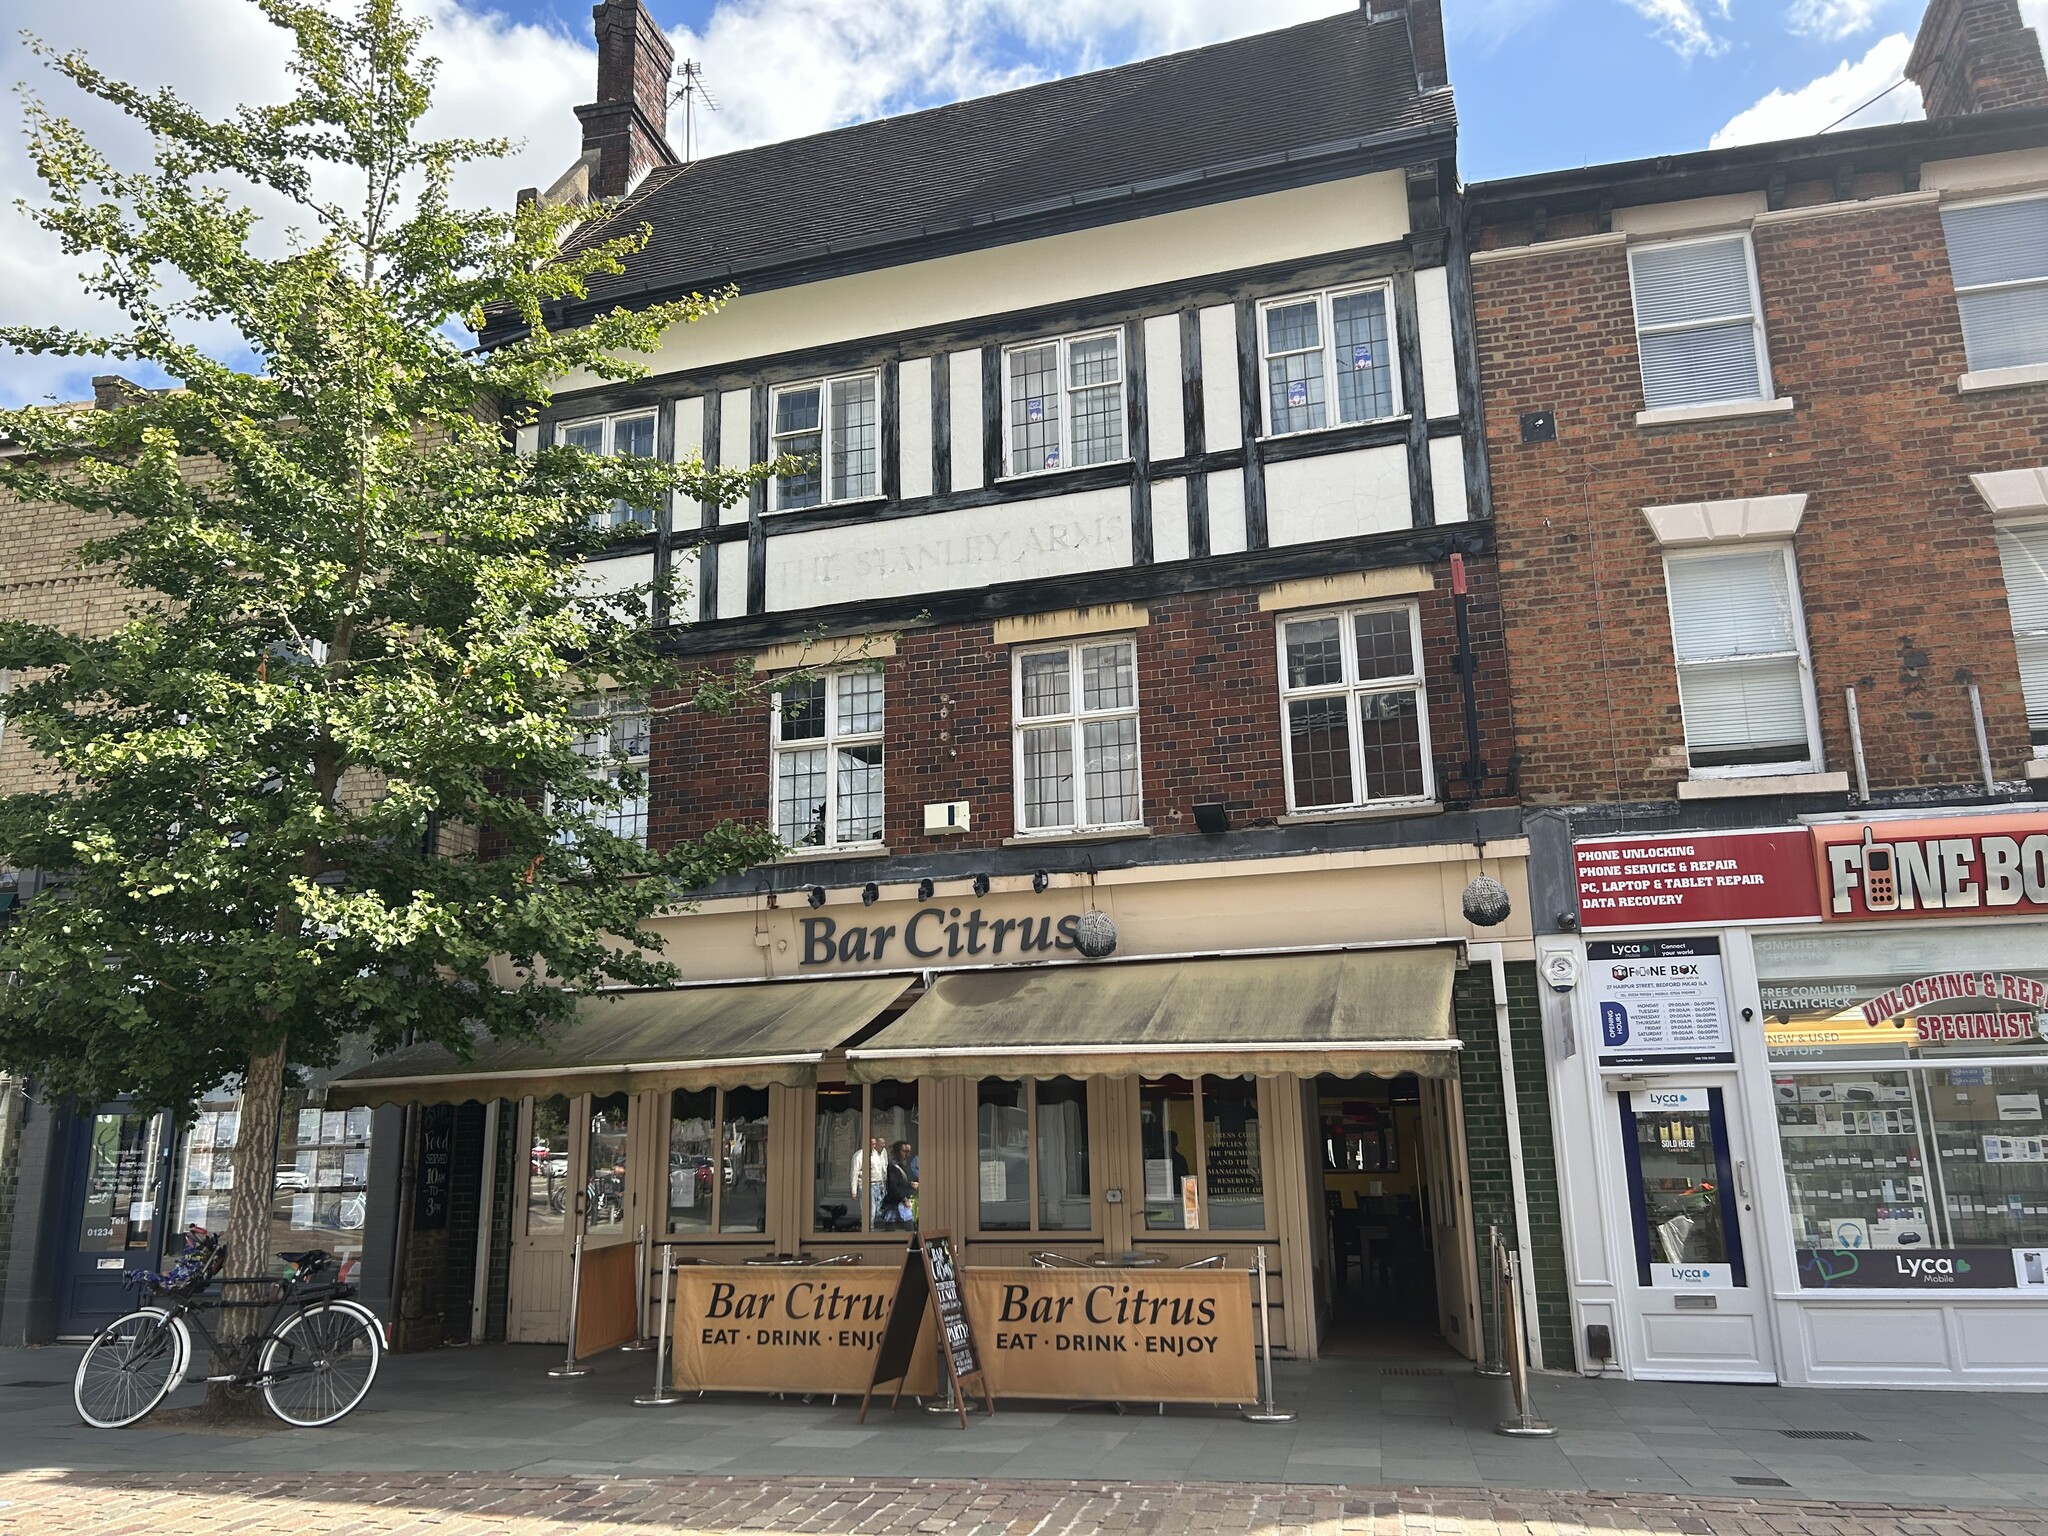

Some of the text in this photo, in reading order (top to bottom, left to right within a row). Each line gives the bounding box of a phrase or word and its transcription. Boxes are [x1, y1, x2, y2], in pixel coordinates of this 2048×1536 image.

[1578, 846, 1694, 862] PHONE UNLOCKING
[1579, 860, 1738, 878] PHONE SERVICE & REPAIR
[1581, 874, 1764, 894] PC, LAPTOP & TABLET REPAIR
[1582, 894, 1684, 909] DATA RECOVERY
[800, 908, 1082, 965] Bar Citrus
[1826, 938, 1872, 947] REPIR
[1611, 944, 1640, 955] Lyca
[1760, 985, 1857, 998] FREE COMPUTER
[1862, 972, 2048, 1028] UNLOCKING & REP
[1762, 998, 1852, 1010] HEALTH CHECK
[1607, 1010, 1616, 1038] OPENING
[1916, 1012, 2034, 1041] SPECIALIST
[1767, 1032, 1840, 1044] NEW & USED
[1769, 1046, 1824, 1057] LAPTOPS
[1650, 1094, 1678, 1104] Lyca
[425, 1128, 450, 1152] Food
[1671, 1268, 1701, 1279] Lyca
[1896, 1255, 1953, 1277] Lyca
[1924, 1274, 1954, 1283] Mobile
[705, 1282, 775, 1319] Bar
[998, 1284, 1216, 1326] Bar Citrus
[702, 1329, 740, 1345] EAT
[757, 1330, 822, 1346] DRINK
[996, 1333, 1218, 1356] EAT DRINK ENJOY
